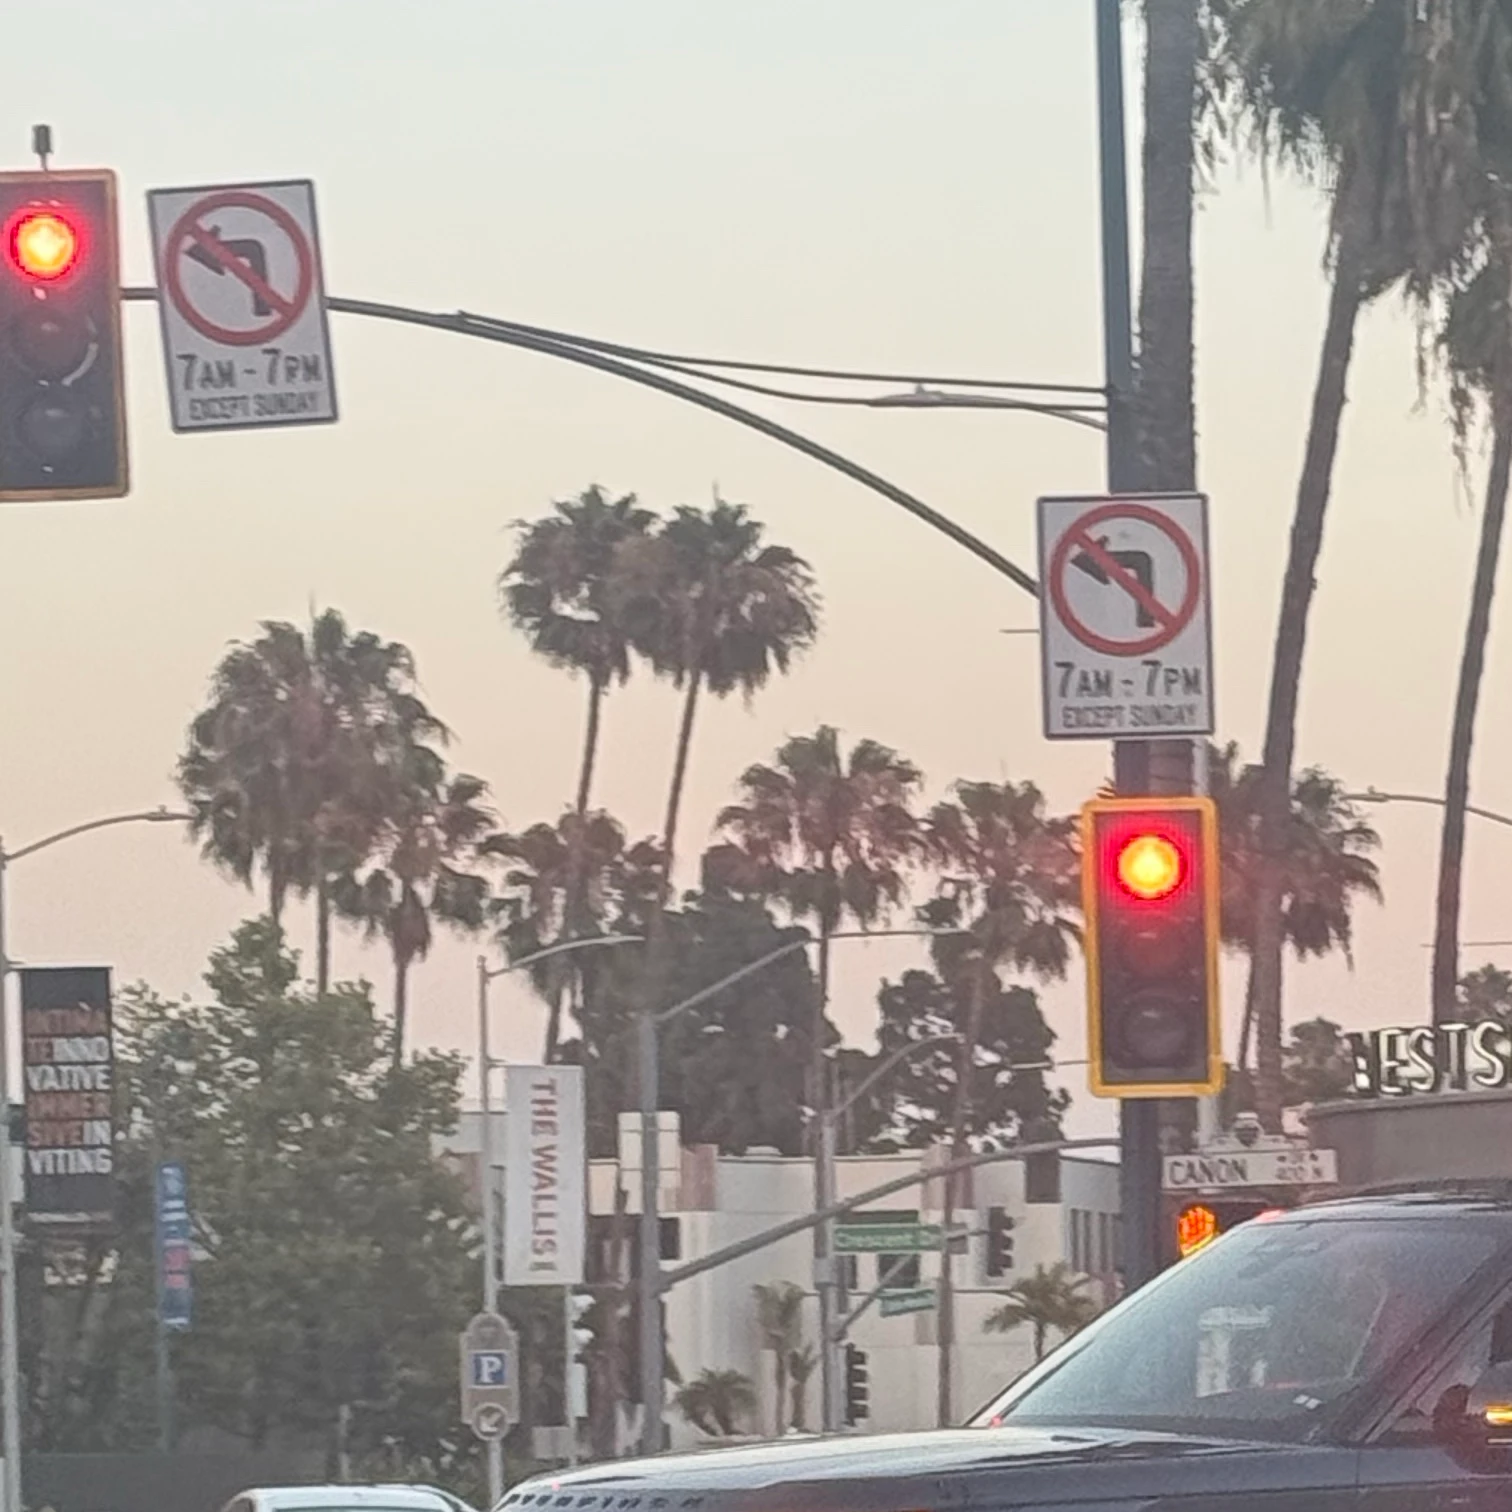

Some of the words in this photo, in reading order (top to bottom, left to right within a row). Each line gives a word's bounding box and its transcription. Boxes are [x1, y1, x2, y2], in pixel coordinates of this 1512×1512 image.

[175, 353, 237, 391] 7AM
[261, 347, 323, 387] 7PM
[188, 394, 250, 421] EXCEPT
[252, 391, 319, 417] SUNDAY
[1054, 661, 1114, 699] 7AM
[1141, 659, 1203, 697] 7PM
[1061, 704, 1126, 729] EXCEPT
[1128, 703, 1197, 728] SUNDAY
[530, 1078, 559, 1137] THE
[1168, 1157, 1249, 1186] CANON
[530, 1144, 559, 1256] WALLIS
[836, 1232, 914, 1249] Crescent
[480, 1355, 502, 1384] P
